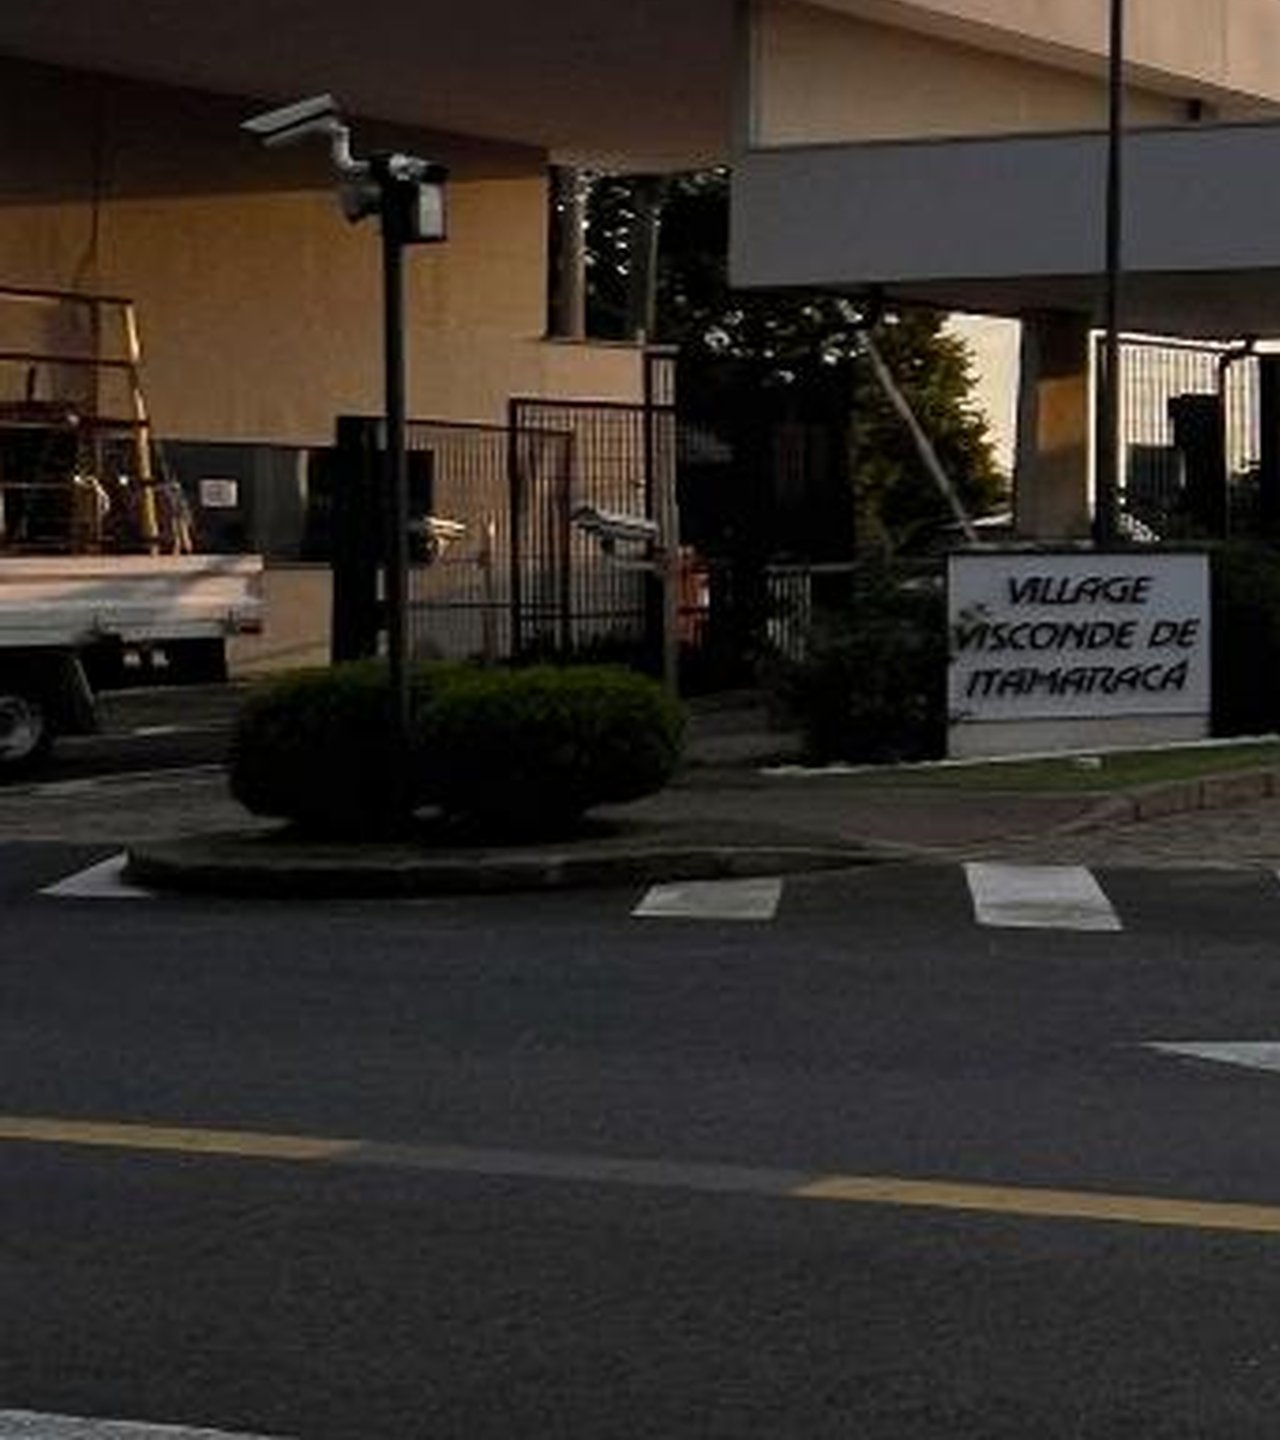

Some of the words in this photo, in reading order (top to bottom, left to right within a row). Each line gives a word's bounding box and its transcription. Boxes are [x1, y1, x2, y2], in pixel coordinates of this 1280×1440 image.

[1008, 576, 1153, 605] VILLAGE
[955, 620, 1137, 651] VISCONDE
[1148, 618, 1201, 649] DE
